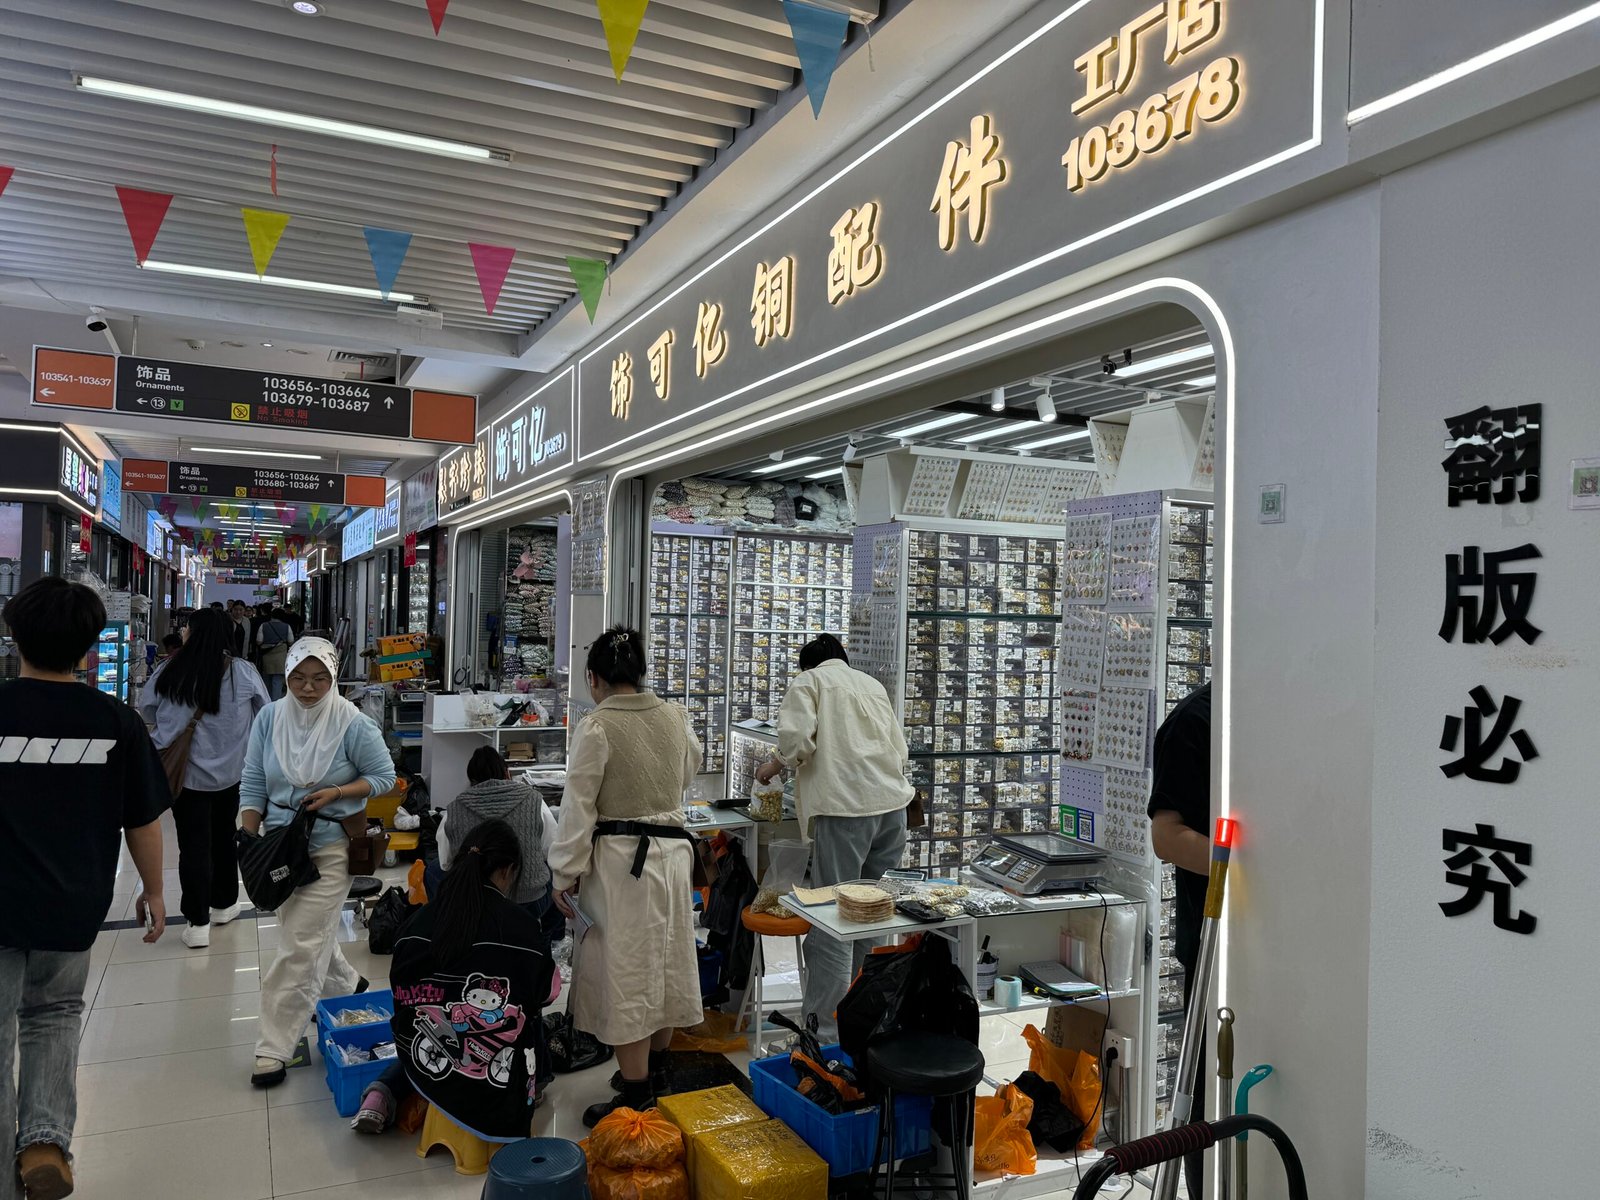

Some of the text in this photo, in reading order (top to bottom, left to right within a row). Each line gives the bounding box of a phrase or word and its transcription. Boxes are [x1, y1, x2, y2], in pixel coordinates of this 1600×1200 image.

[1071, 0, 1221, 116] 工厂店
[1062, 57, 1240, 192] 103678
[40, 371, 112, 387] 103541-103637
[136, 364, 171, 381] 饰品
[135, 380, 185, 392] Ornaments
[262, 376, 371, 399] 103656-103664
[262, 391, 370, 412] 103679-103687
[257, 405, 309, 419] 禁止吸烟
[254, 470, 320, 482] 103656-103664
[254, 478, 320, 490] 103680-103687
[1438, 402, 1542, 934] 翻版必究
